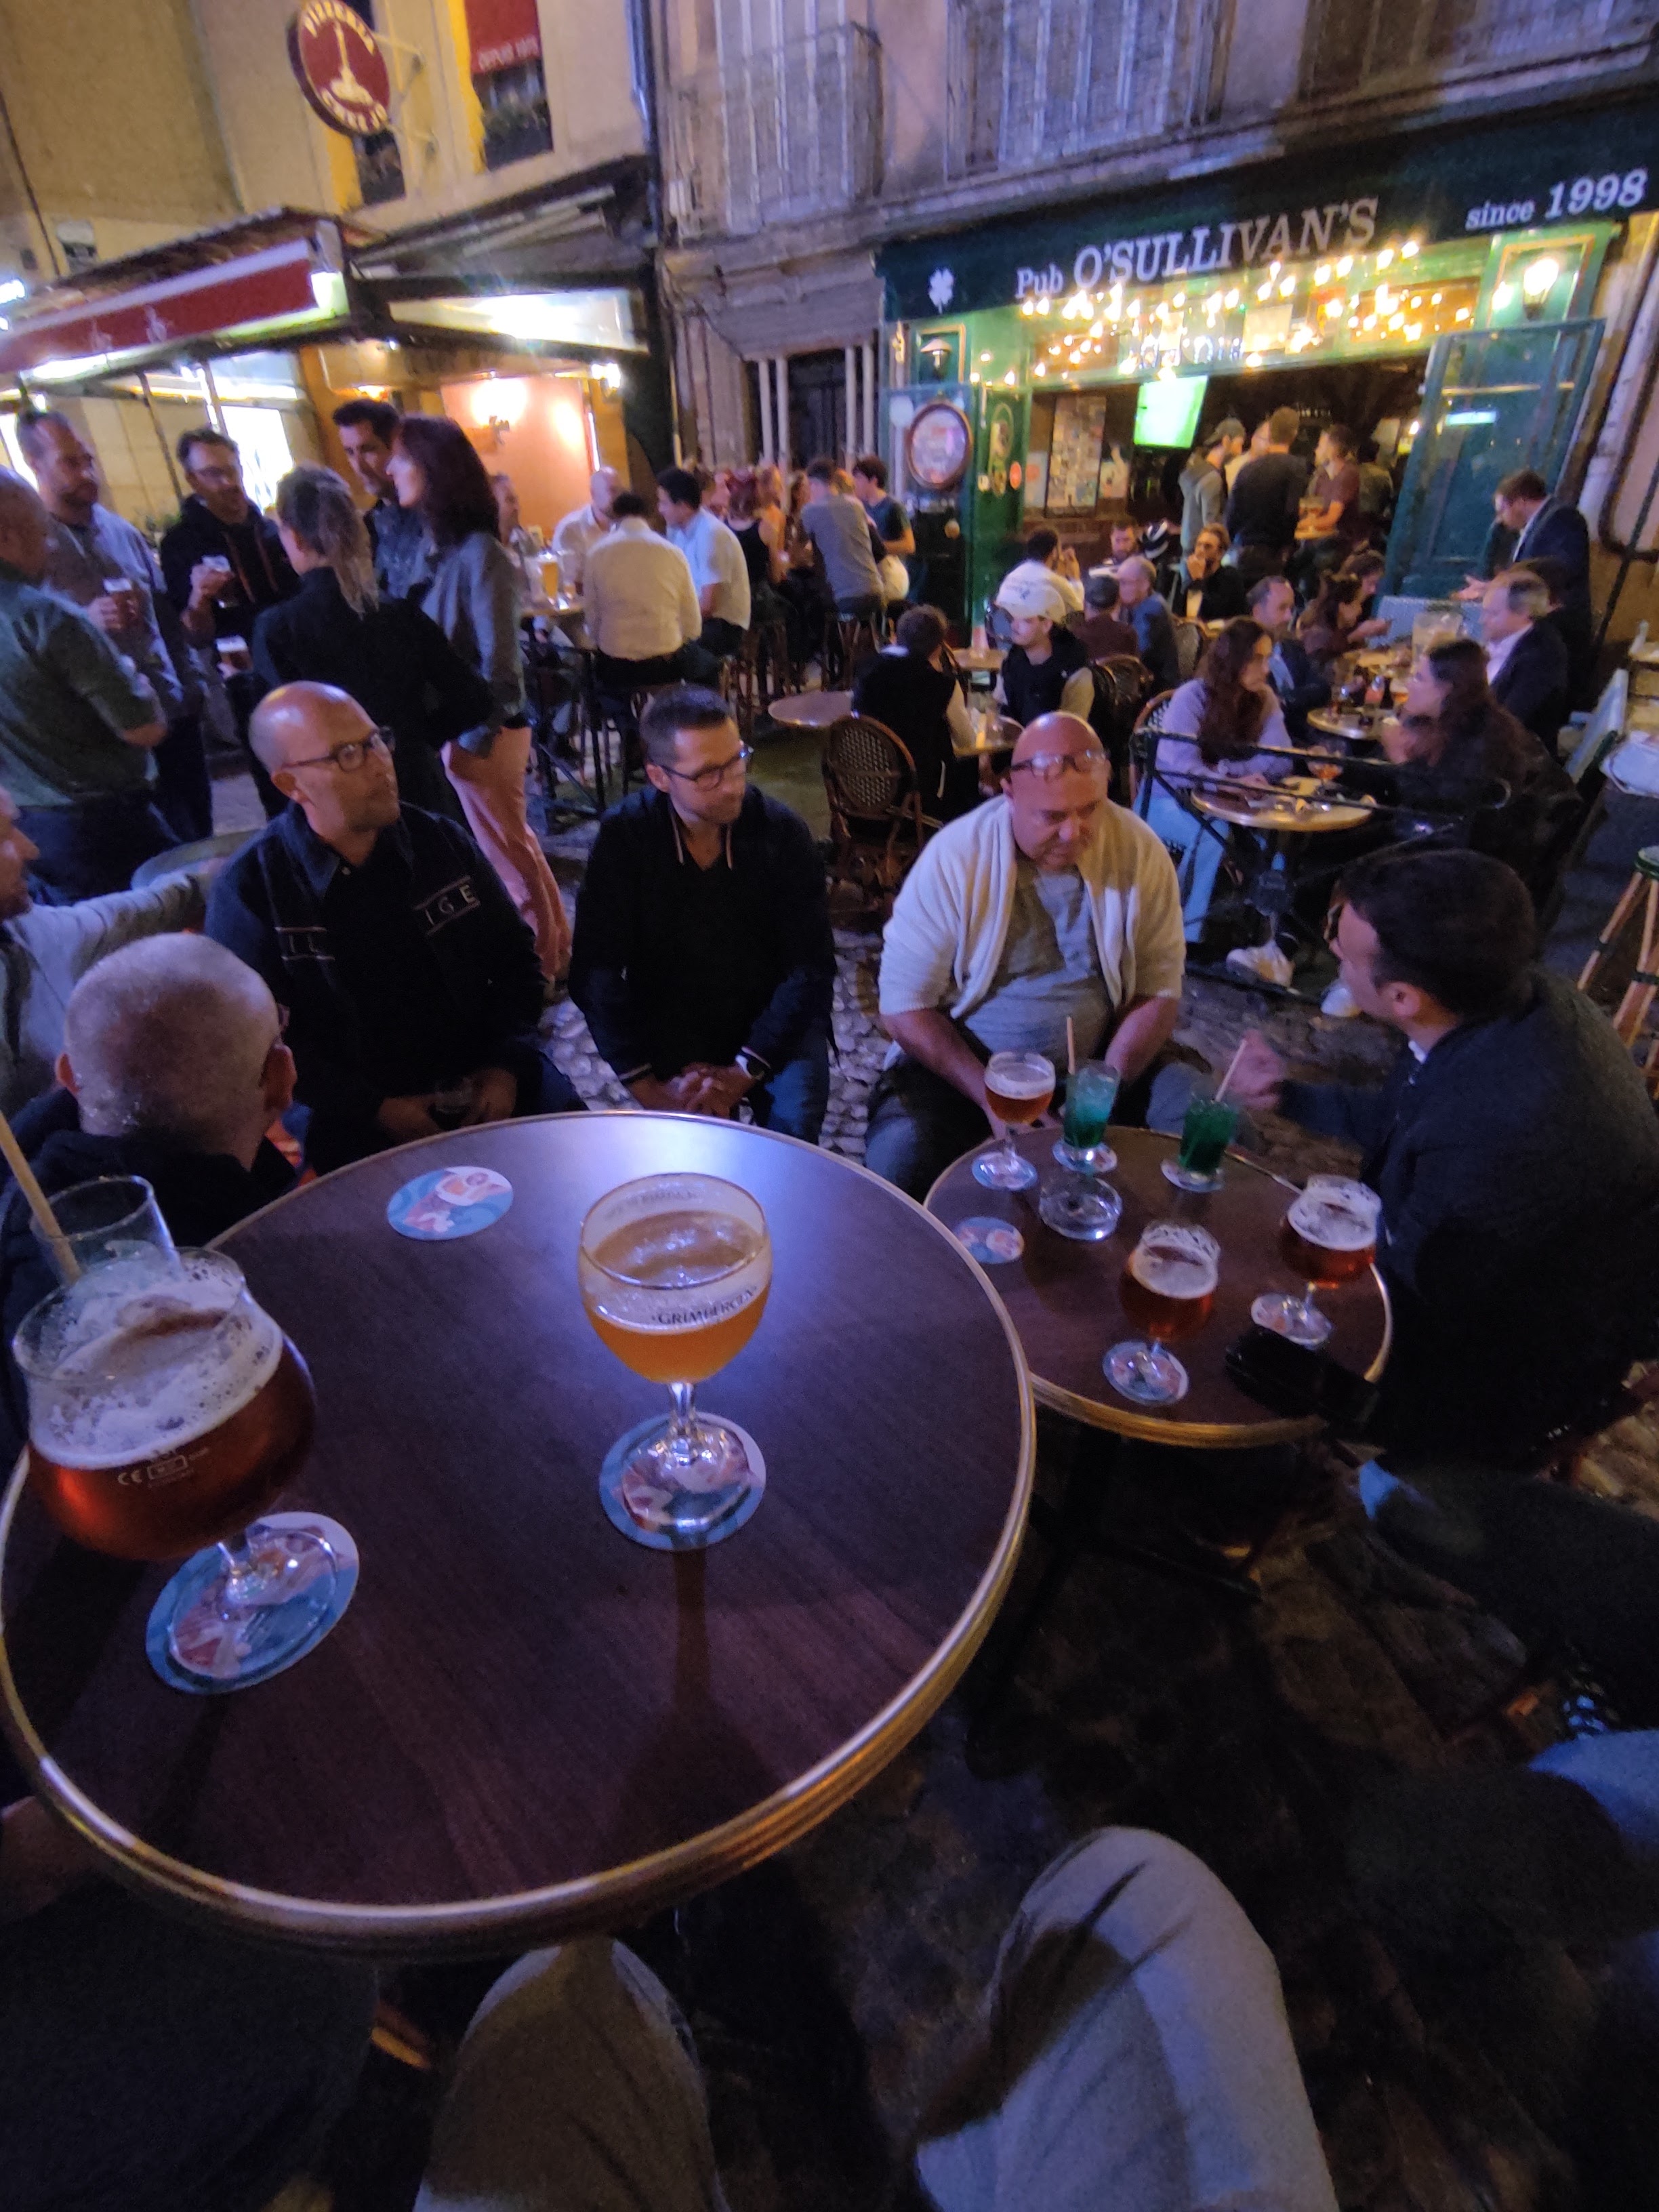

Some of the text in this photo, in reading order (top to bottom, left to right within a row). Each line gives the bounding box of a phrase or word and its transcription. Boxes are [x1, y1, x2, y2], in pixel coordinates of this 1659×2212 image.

[1015, 167, 1649, 299] Pub O'SULLIVAN'S since 1998
